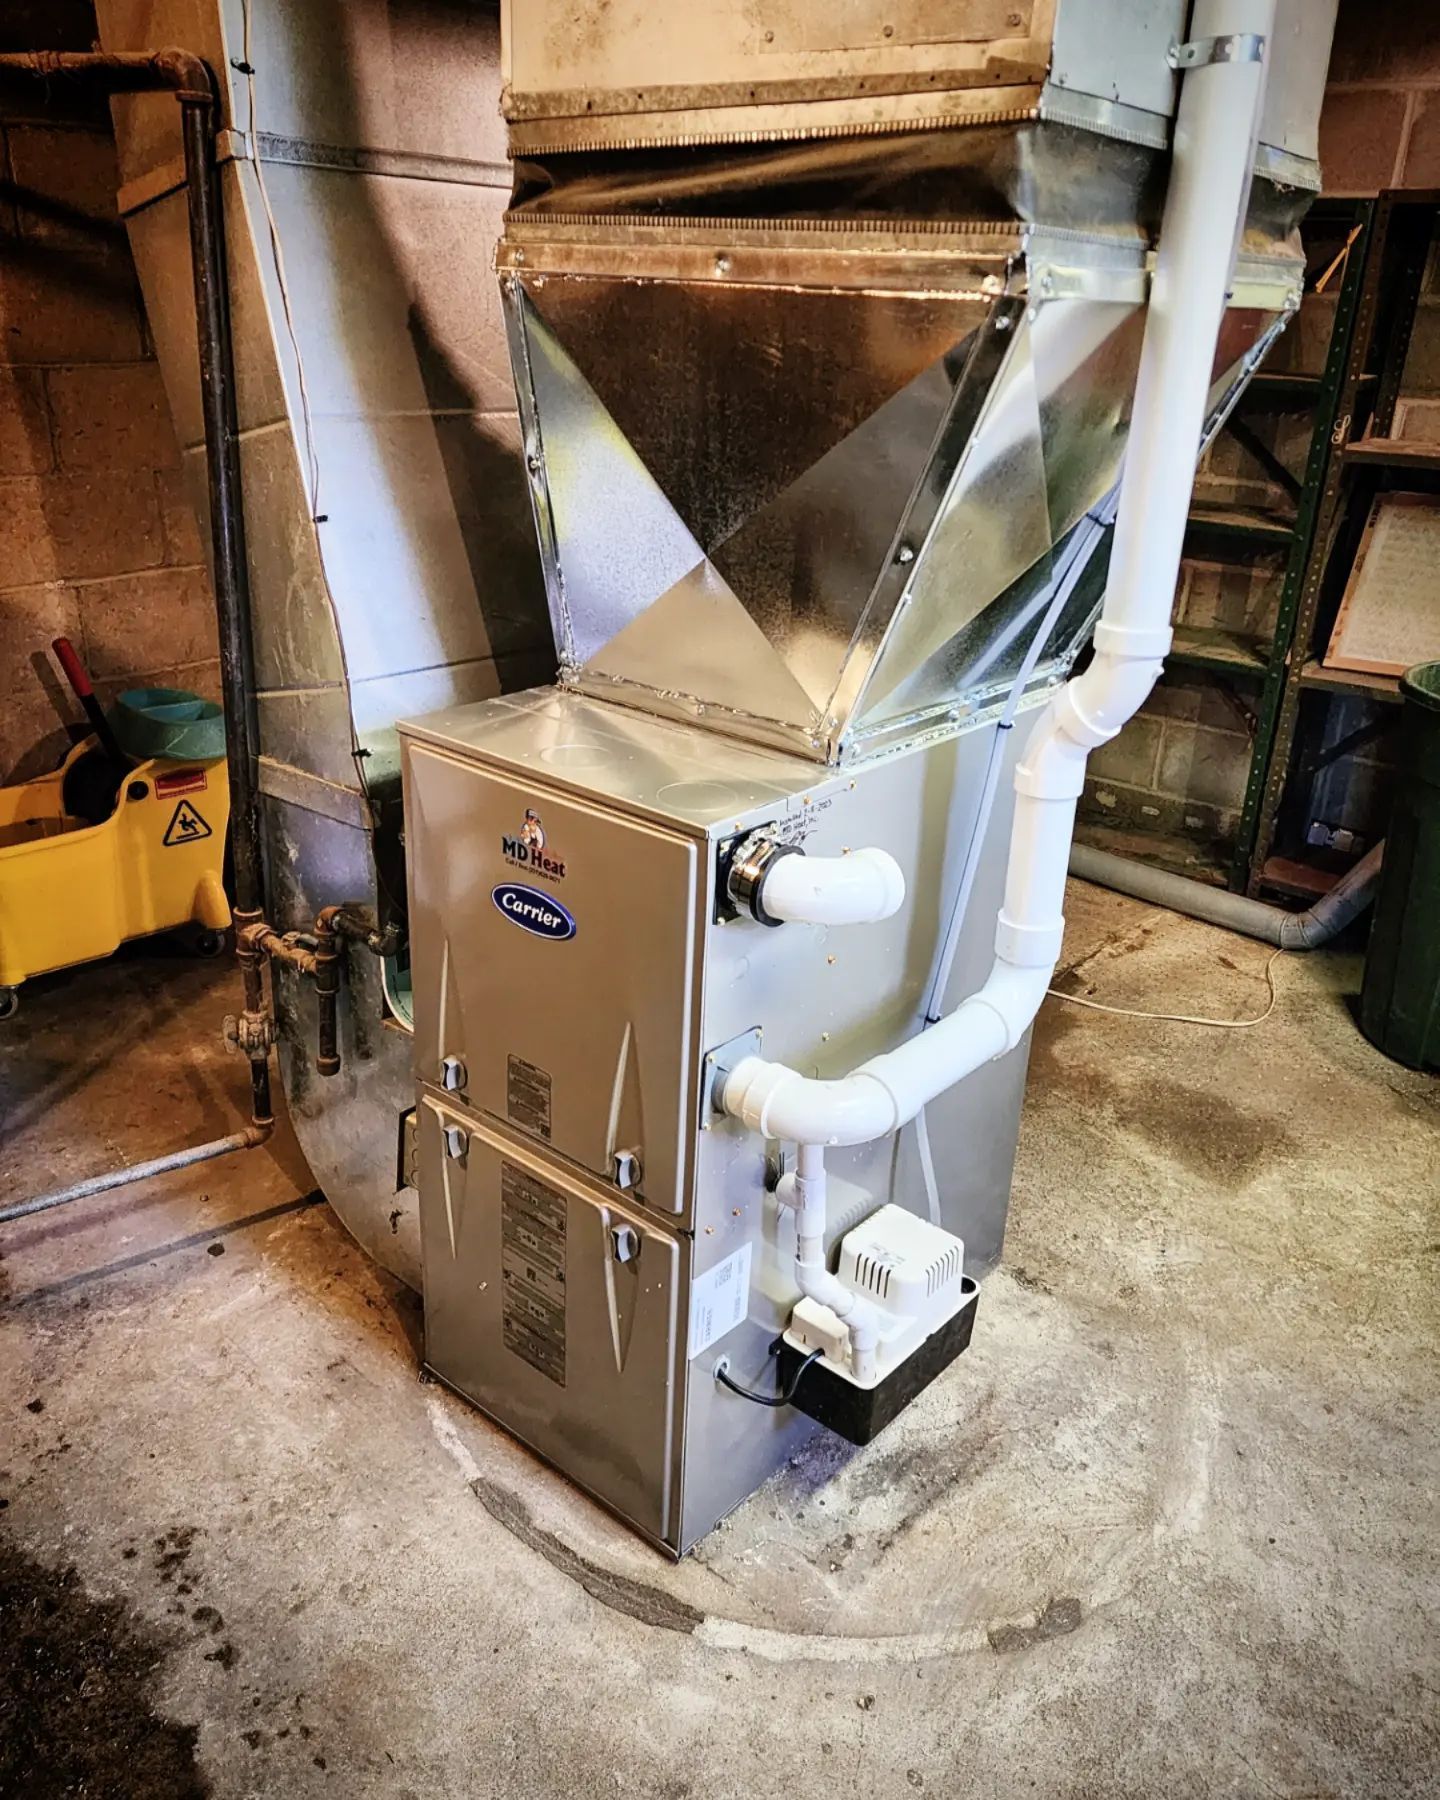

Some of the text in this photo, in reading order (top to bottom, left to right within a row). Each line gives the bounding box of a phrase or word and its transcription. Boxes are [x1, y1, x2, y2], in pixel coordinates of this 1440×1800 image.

[502, 837, 528, 861] MD
[531, 848, 566, 878] Heat
[502, 893, 561, 928] Carrier
